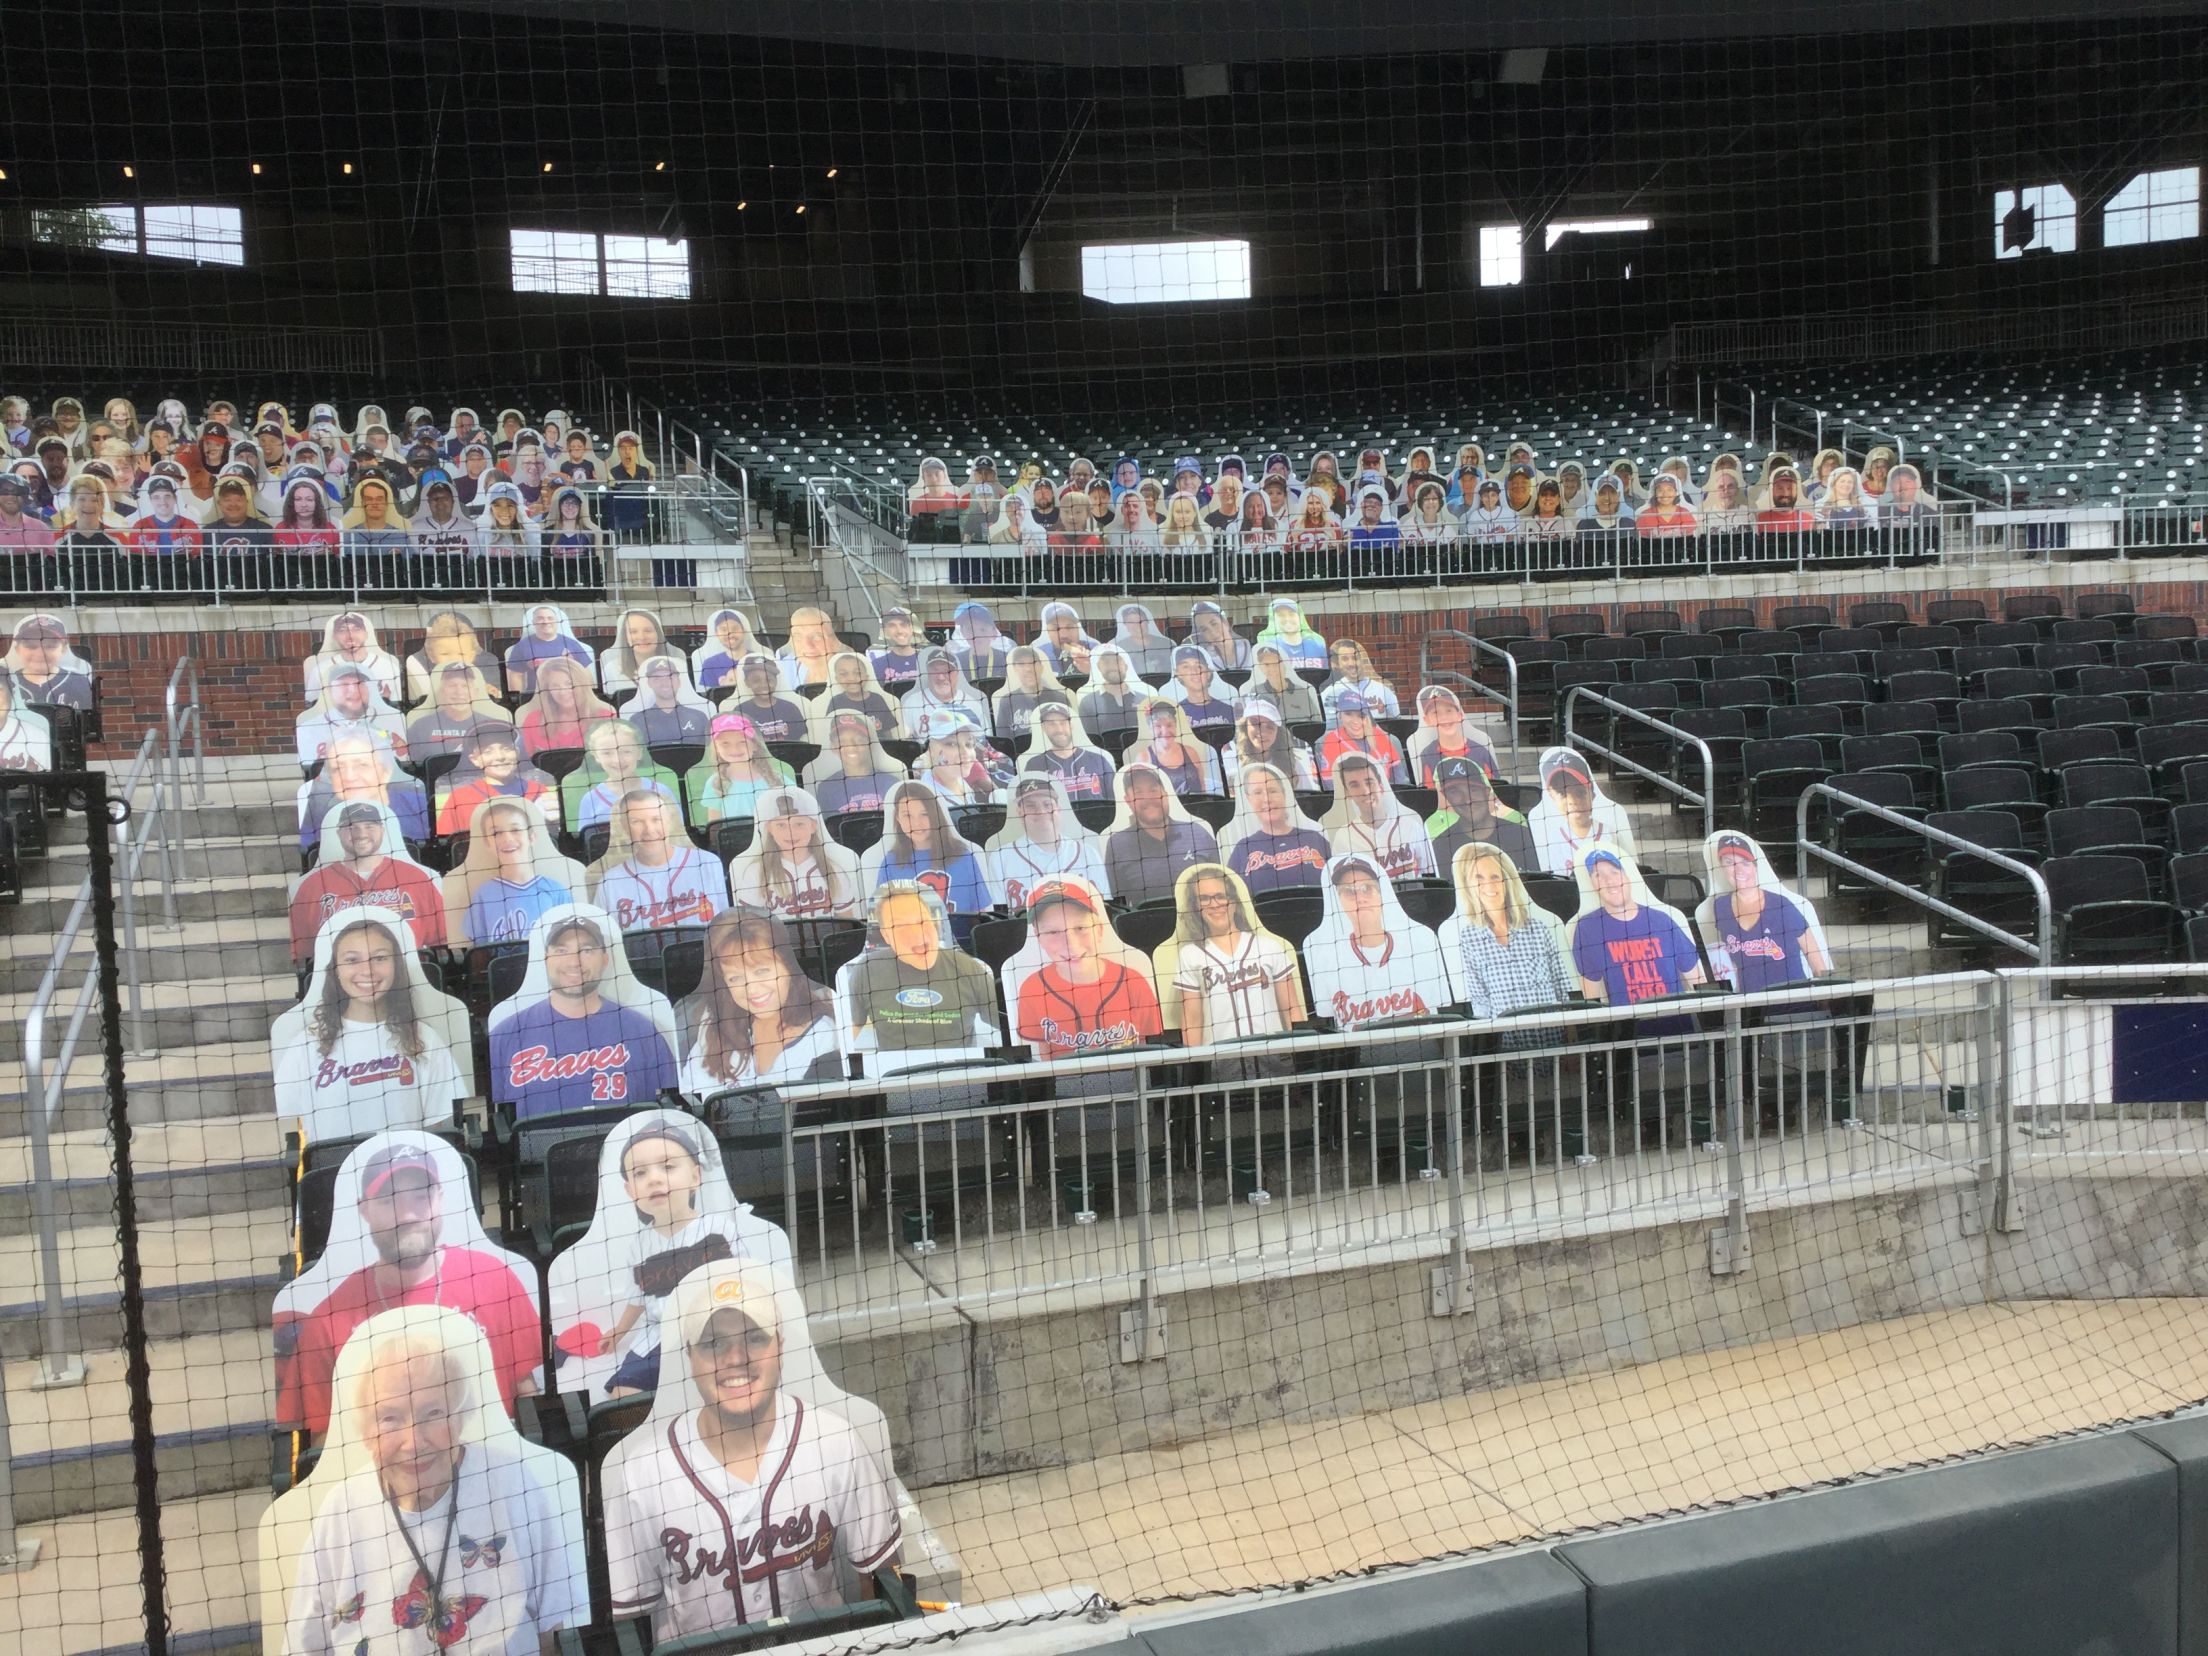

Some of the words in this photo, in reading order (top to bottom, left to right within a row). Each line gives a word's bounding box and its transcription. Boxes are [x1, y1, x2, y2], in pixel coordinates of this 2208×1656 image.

[682, 720, 695, 731] A
[1448, 762, 1466, 776] A
[1553, 754, 1570, 765] A
[1024, 780, 1038, 792] A
[1183, 850, 1195, 861] A
[1245, 845, 1312, 877] Braves
[617, 887, 699, 931] Braves
[1607, 937, 1664, 964] WORST
[1725, 934, 1771, 955] Braves
[1202, 963, 1259, 994] Braves
[1622, 960, 1663, 985] CALL
[1332, 987, 1412, 1026] Braves
[1041, 1018, 1126, 1049] Braves
[315, 1053, 401, 1092] Braves
[510, 1042, 632, 1088] Braves
[591, 1071, 628, 1101] 29
[394, 1144, 418, 1161] A
[660, 1503, 813, 1586] Braves
